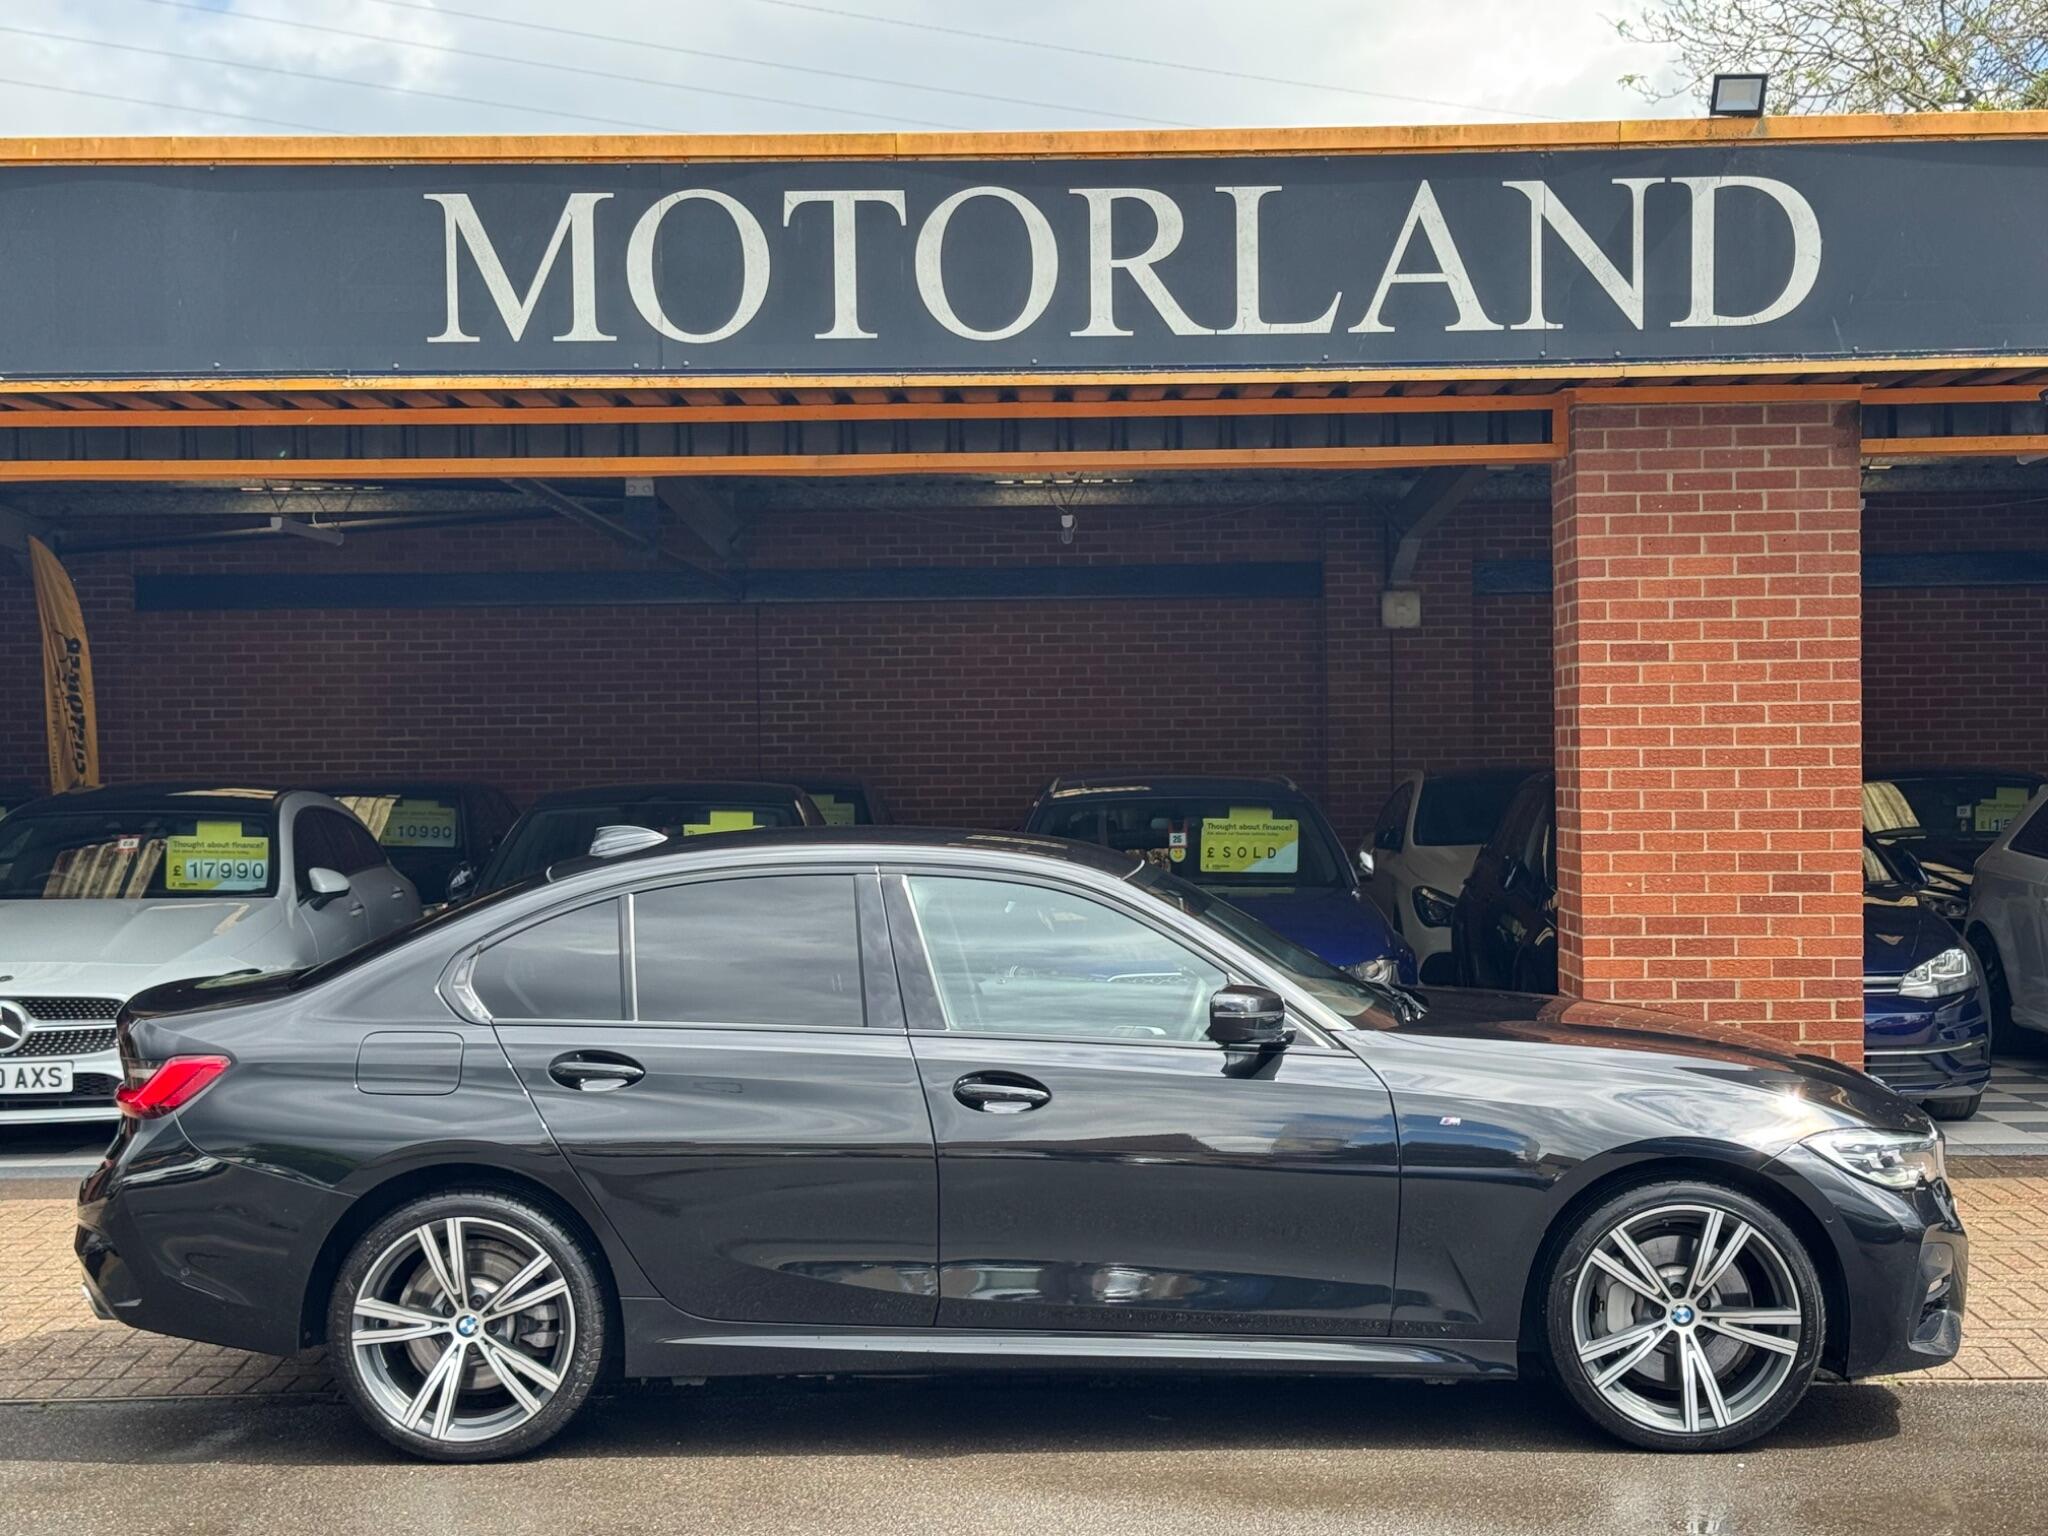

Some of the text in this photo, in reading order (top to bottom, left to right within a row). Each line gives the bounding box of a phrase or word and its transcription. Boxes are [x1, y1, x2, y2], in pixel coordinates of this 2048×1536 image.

[423, 176, 1822, 343] MOTORLAND
[1207, 823, 1237, 831] Thought
[172, 841, 205, 849] Thought
[15, 1067, 63, 1088] AXS
